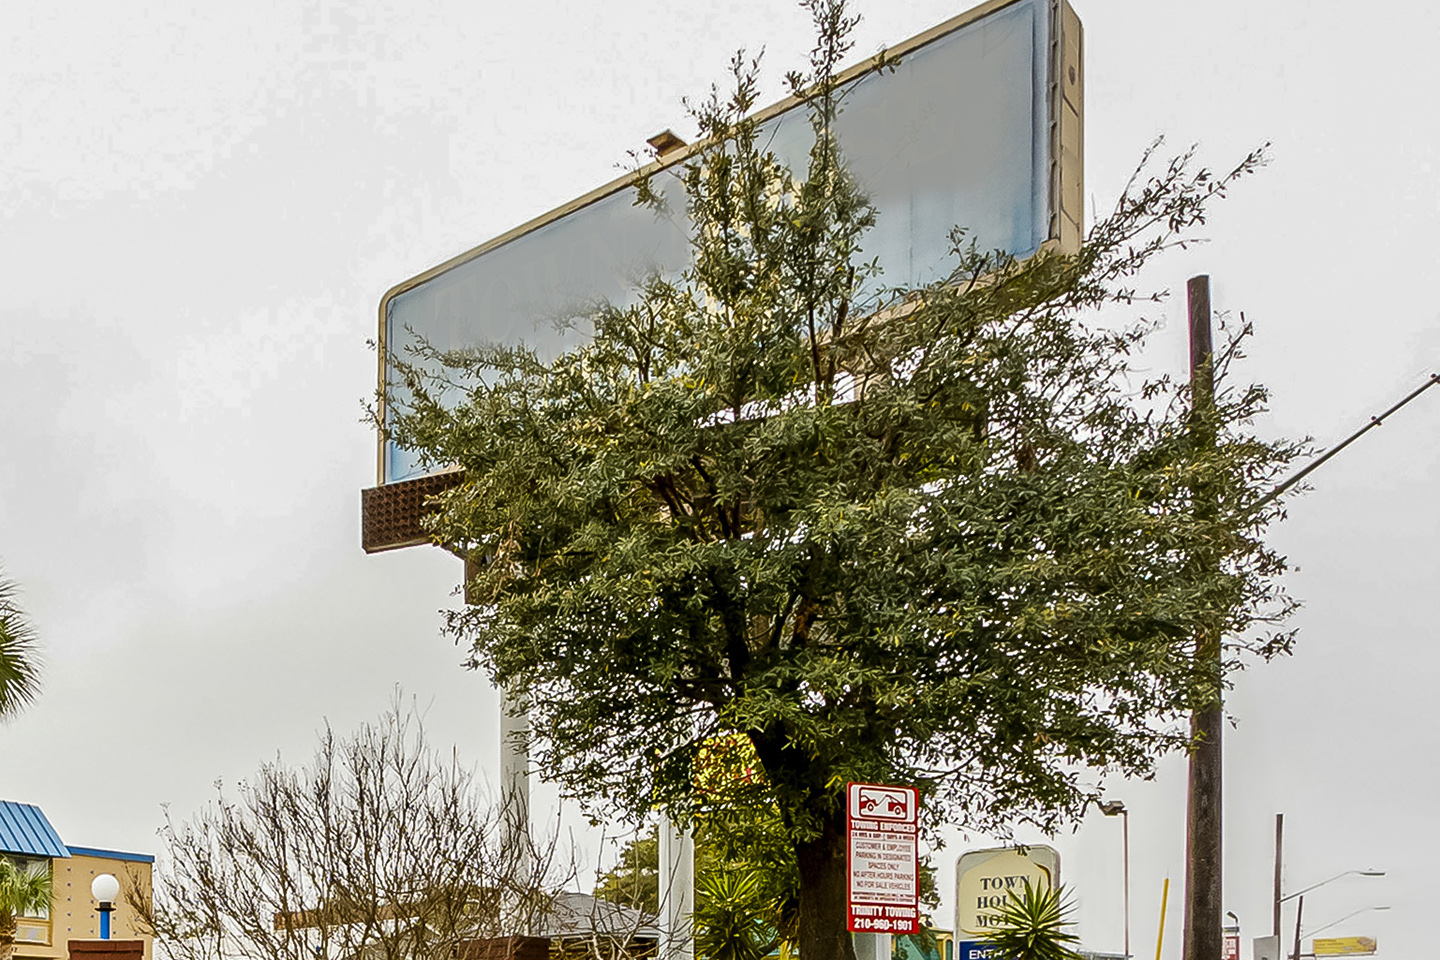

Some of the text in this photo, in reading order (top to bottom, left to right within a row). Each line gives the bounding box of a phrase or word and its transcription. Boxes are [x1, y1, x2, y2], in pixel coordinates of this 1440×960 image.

[851, 820, 878, 830] TOWING
[856, 841, 880, 850] CUSTOMER
[856, 851, 876, 859] PARKING
[980, 875, 1030, 890] TOWN
[977, 893, 1028, 909] HOU
[851, 905, 916, 918] TRINITY TOWING
